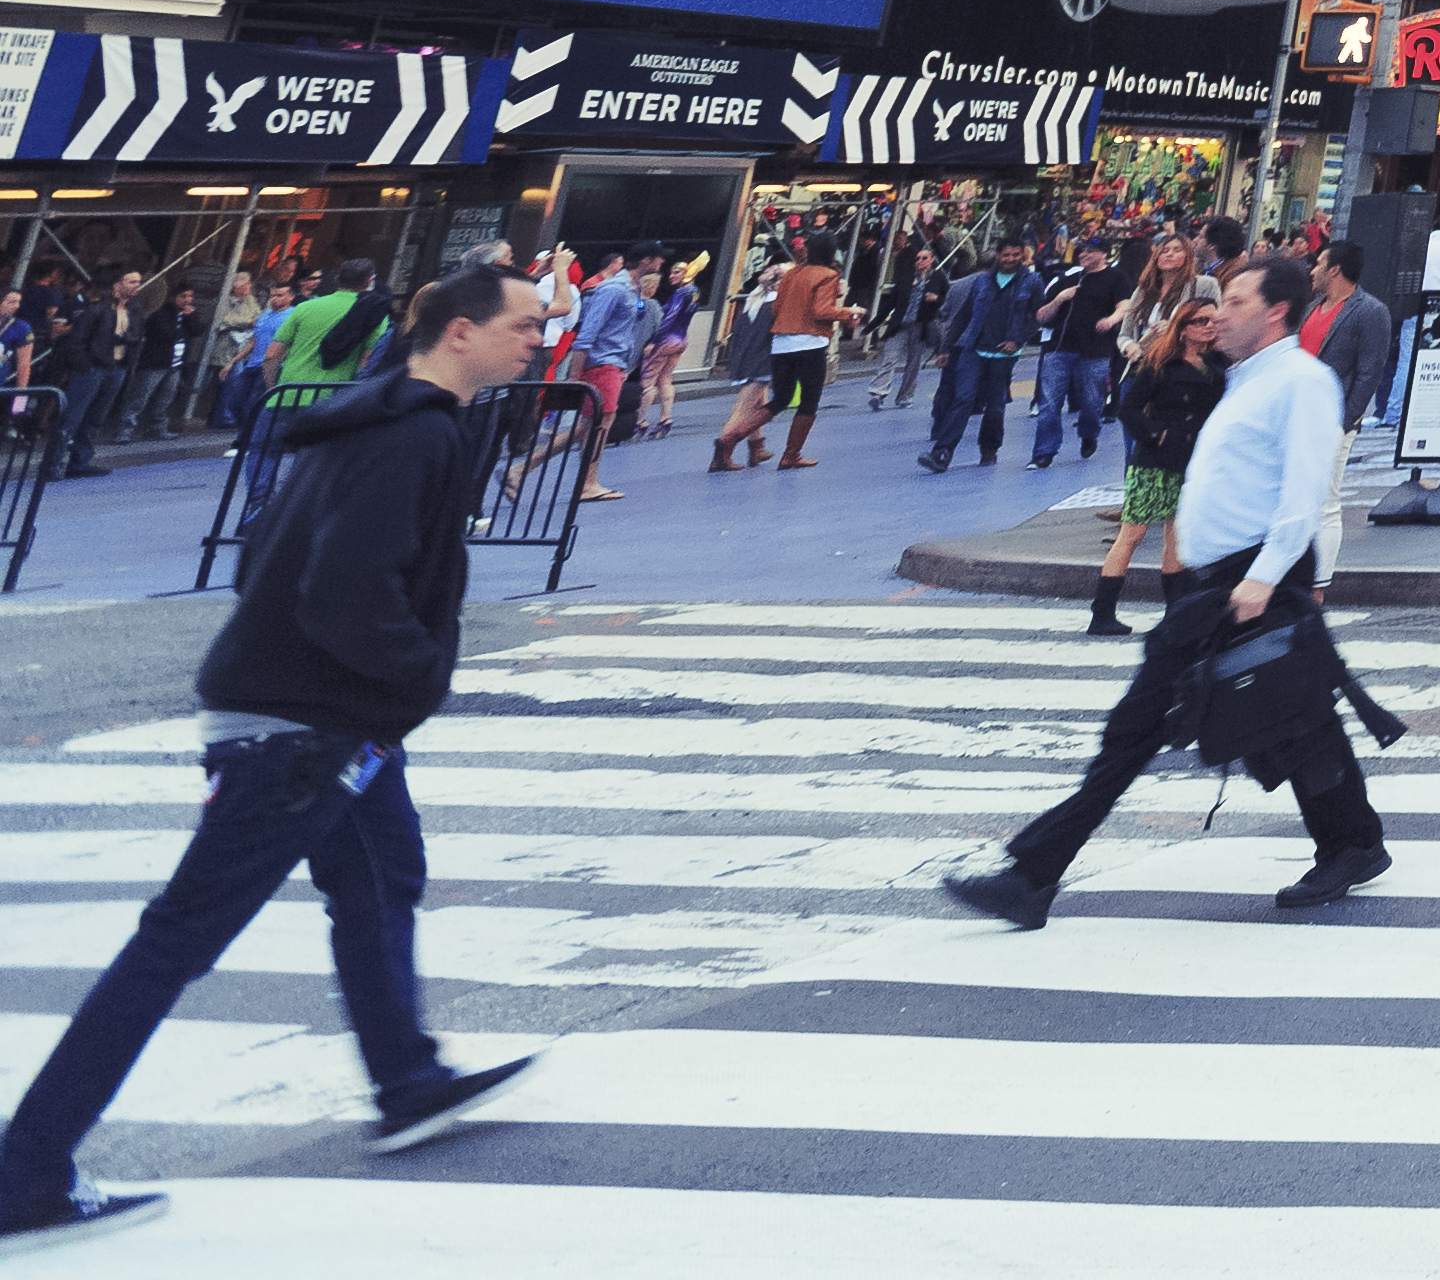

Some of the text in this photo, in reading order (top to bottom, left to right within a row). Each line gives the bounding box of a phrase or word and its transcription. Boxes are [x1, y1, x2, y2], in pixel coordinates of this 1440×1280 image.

[630, 53, 740, 74] AMERICAN EAGLE
[276, 75, 375, 103] WE'RE
[650, 71, 716, 86] OUTFITTERS
[579, 90, 762, 126] ENTER HERE
[970, 99, 1020, 121] WE'RE
[265, 109, 350, 136] OPEN
[963, 123, 1008, 143] OPEN
[1420, 373, 1440, 381] NEW
